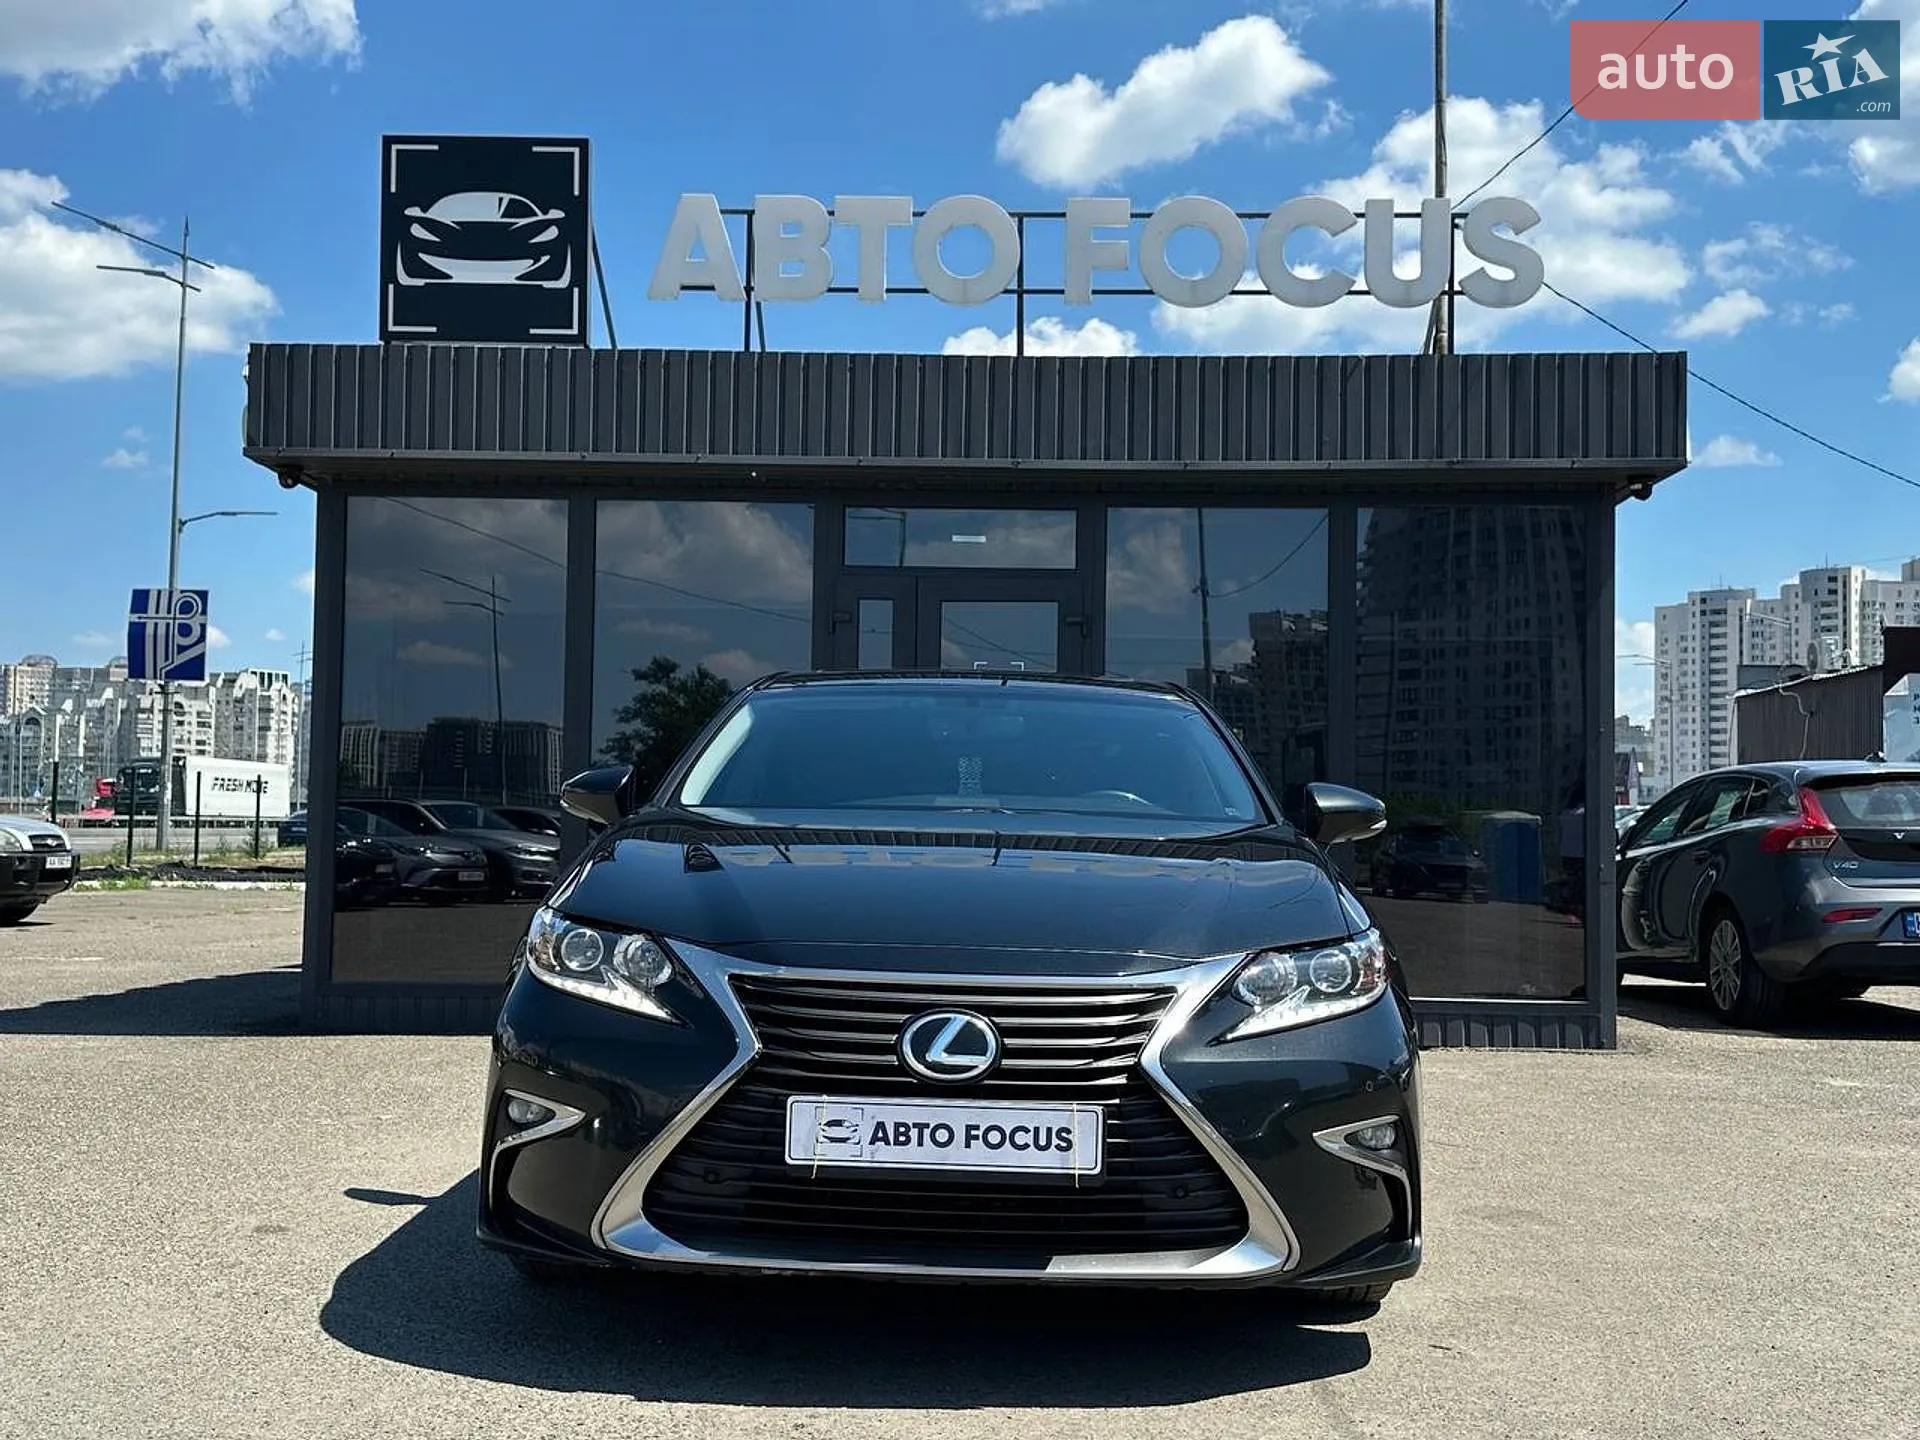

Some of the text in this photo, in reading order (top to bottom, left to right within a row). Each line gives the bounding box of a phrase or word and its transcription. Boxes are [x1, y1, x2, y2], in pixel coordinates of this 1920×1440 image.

[647, 193, 1544, 308] АВТО FOCUS
[1832, 861, 1859, 869] V40
[868, 1120, 1074, 1151] АВТО FOCUS
